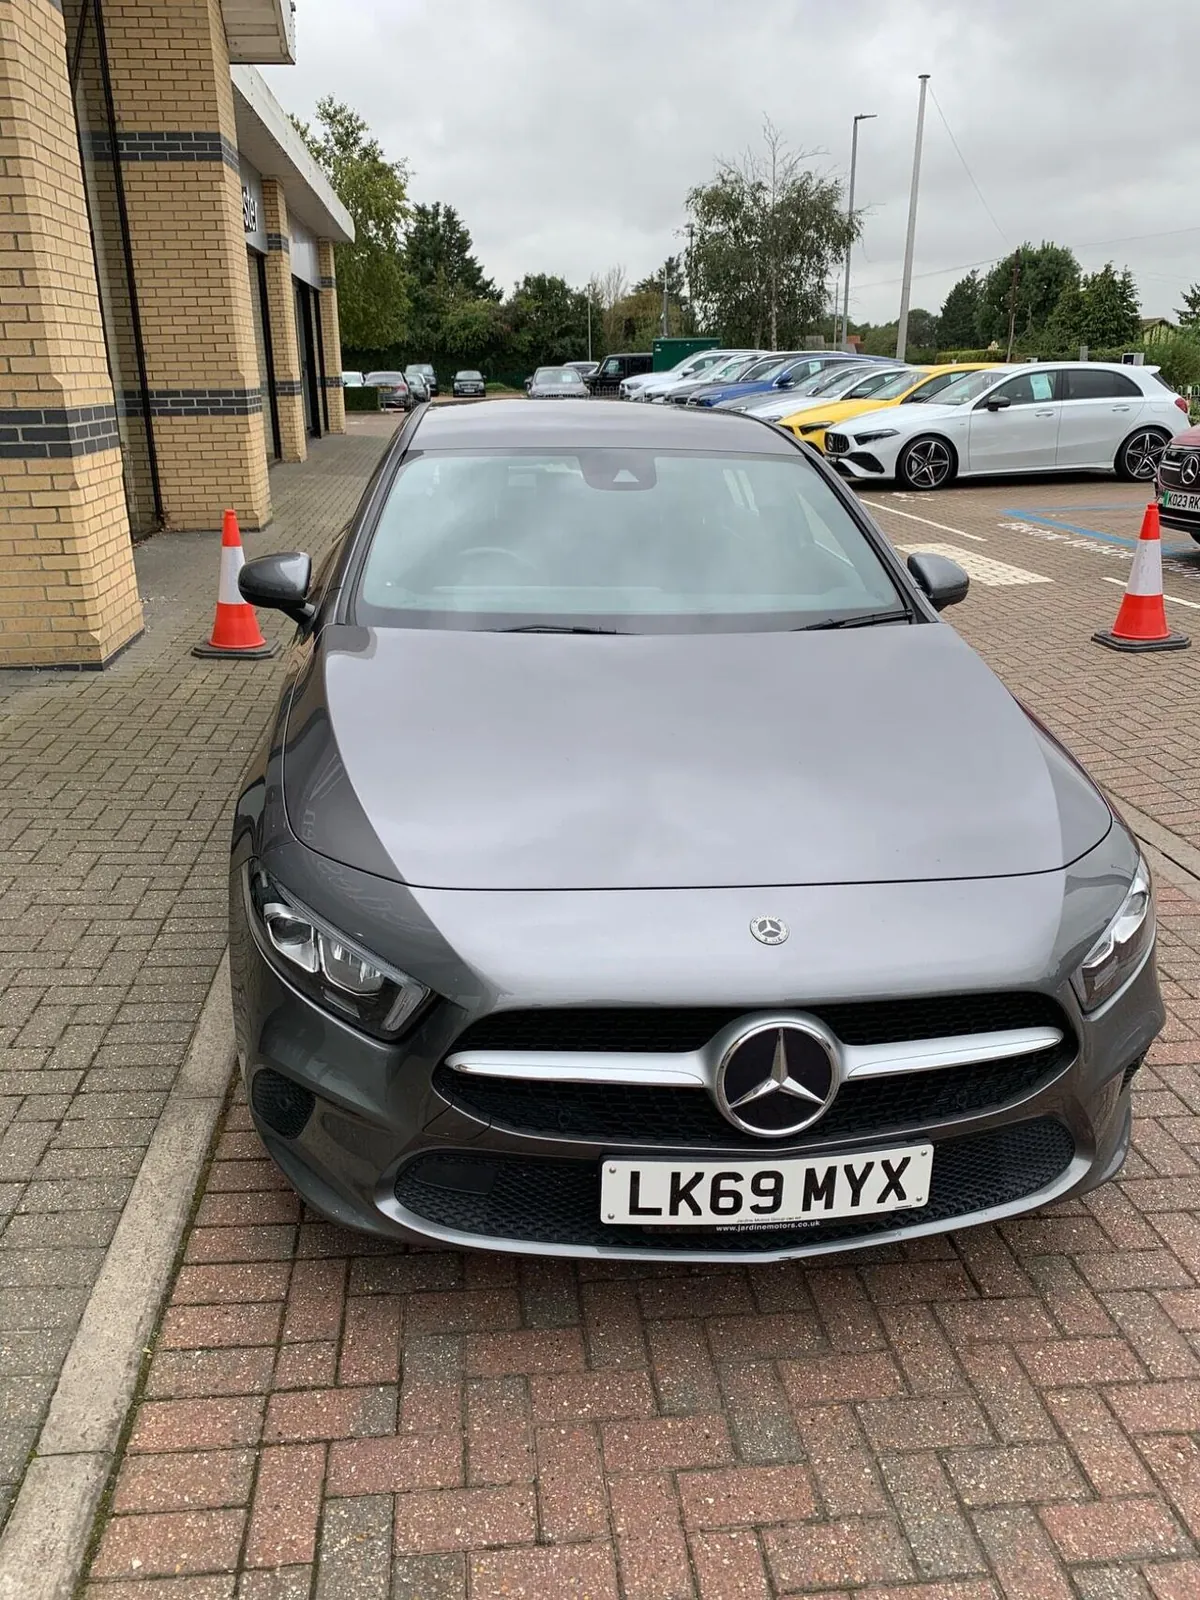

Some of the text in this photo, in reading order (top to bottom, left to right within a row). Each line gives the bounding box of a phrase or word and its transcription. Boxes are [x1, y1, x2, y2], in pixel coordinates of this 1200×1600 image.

[1188, 496, 1200, 509] RK
[629, 1156, 911, 1217] LK69 MYX
[715, 1219, 821, 1232] www.jardinemotors.co.uk
